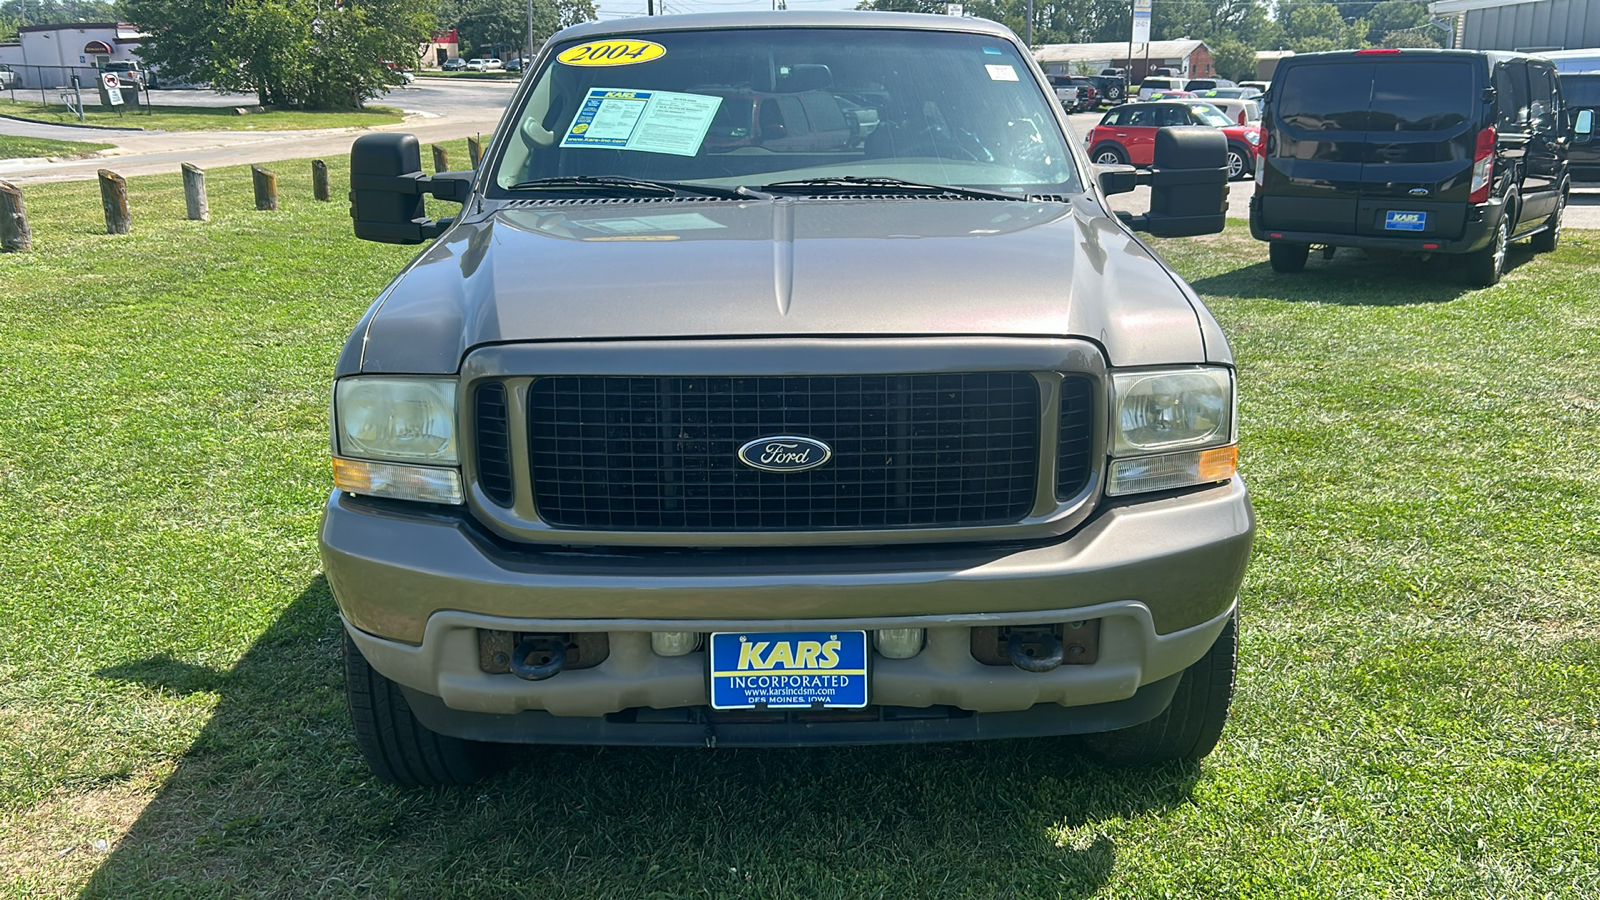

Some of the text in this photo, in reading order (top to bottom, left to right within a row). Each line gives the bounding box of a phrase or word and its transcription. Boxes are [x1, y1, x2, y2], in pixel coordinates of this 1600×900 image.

[568, 44, 651, 62] 2004
[1393, 213, 1419, 222] KARS
[760, 443, 811, 464] Ford
[737, 641, 841, 670] KARS
[730, 675, 849, 689] INCORPORATED
[744, 686, 836, 697] www.karsincdsm.com
